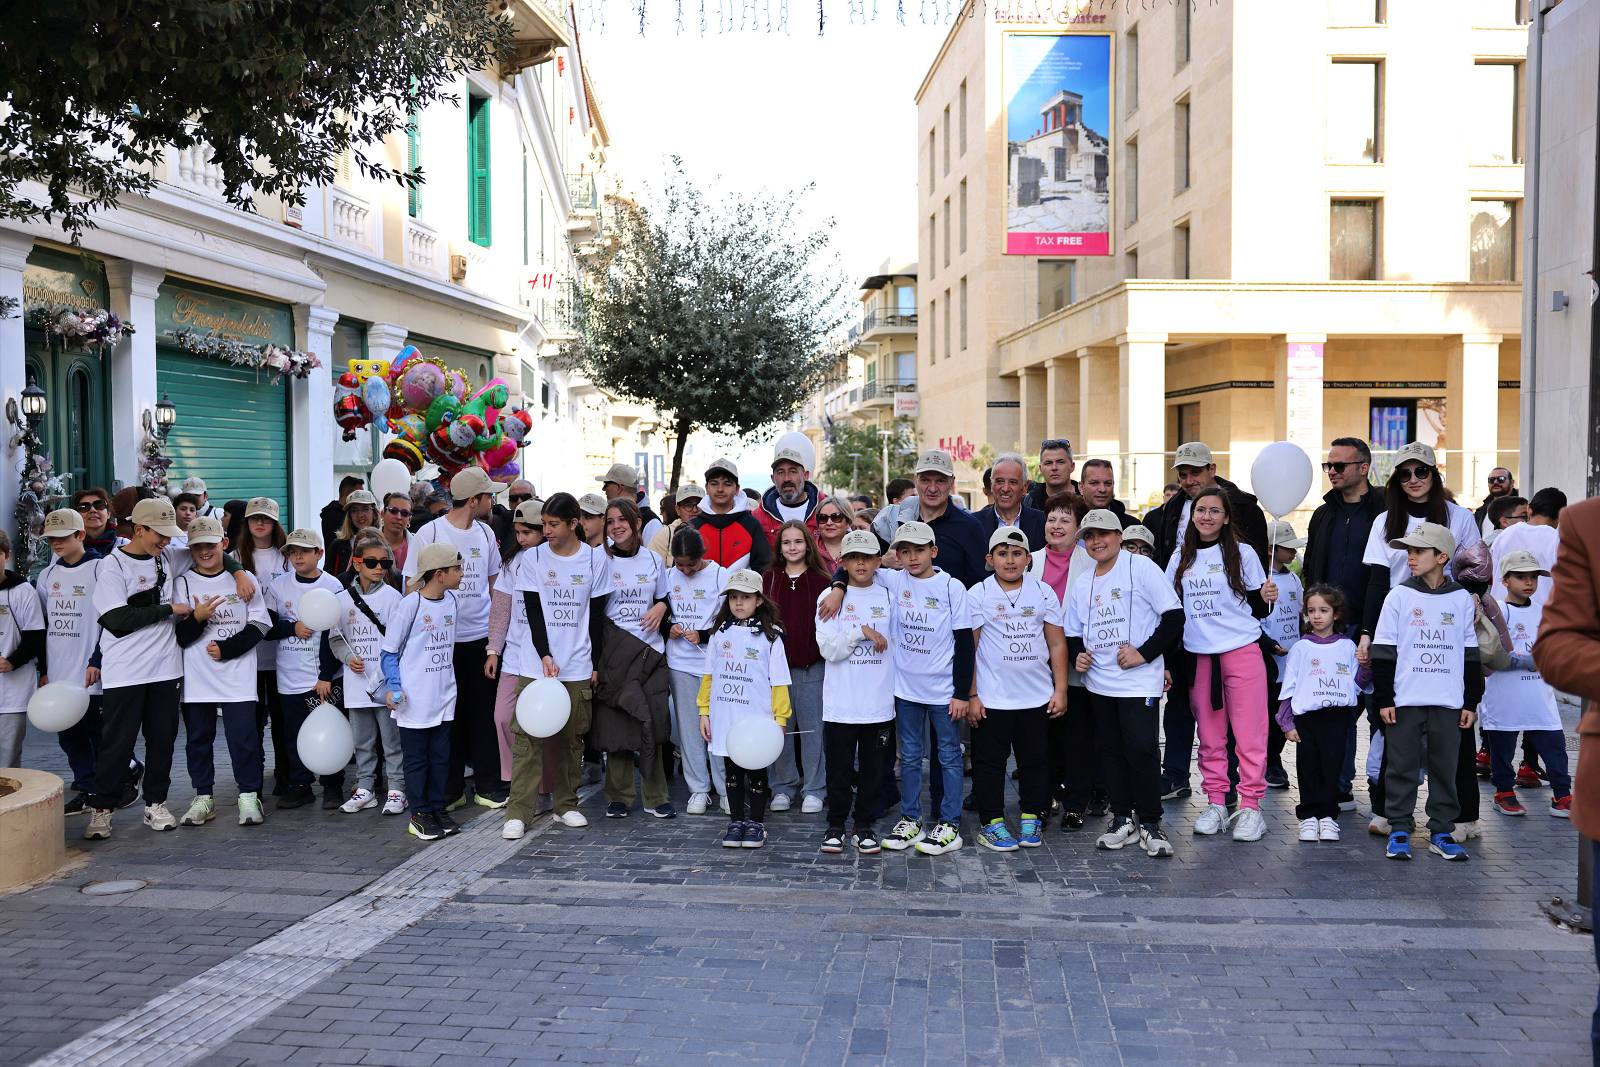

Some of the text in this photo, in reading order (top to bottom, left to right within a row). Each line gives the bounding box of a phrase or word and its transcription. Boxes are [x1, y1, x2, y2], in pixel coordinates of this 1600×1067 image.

[1034, 236, 1083, 246] TAX FREE
[1189, 578, 1212, 590] ΝΑΙ
[553, 589, 575, 599] ΝΑΙ
[620, 588, 642, 599] ΝΑΙ
[55, 600, 76, 610] ΝΑΙ
[677, 603, 697, 613] ΝΑΙ
[1193, 599, 1214, 611] ΟΧΙ
[553, 609, 574, 620] ΟΧΙ
[619, 607, 640, 618] ΟΧΙ
[905, 610, 928, 624] ΝΑΙ
[1096, 605, 1117, 619] ΝΑΙ
[54, 619, 74, 630] ΟΧΙ
[1005, 622, 1028, 633] ΝΑΙ
[353, 626, 372, 636] ΝΑΙ
[1097, 627, 1120, 640] ΟΧΙ
[1420, 629, 1445, 641] ΝΑΙ
[431, 631, 449, 644] ΝΑΙ
[904, 632, 925, 646] ΟΧΙ
[355, 645, 372, 655] ΟΧΙ
[1009, 642, 1032, 653] ΟΧΙ
[431, 652, 449, 664] ΟΧΙ
[1420, 652, 1445, 665] ΟΧΙ
[725, 661, 748, 674] ΝΑΙ
[1318, 677, 1340, 689] ΝΑΙ
[723, 683, 744, 696] ΟΧΙ
